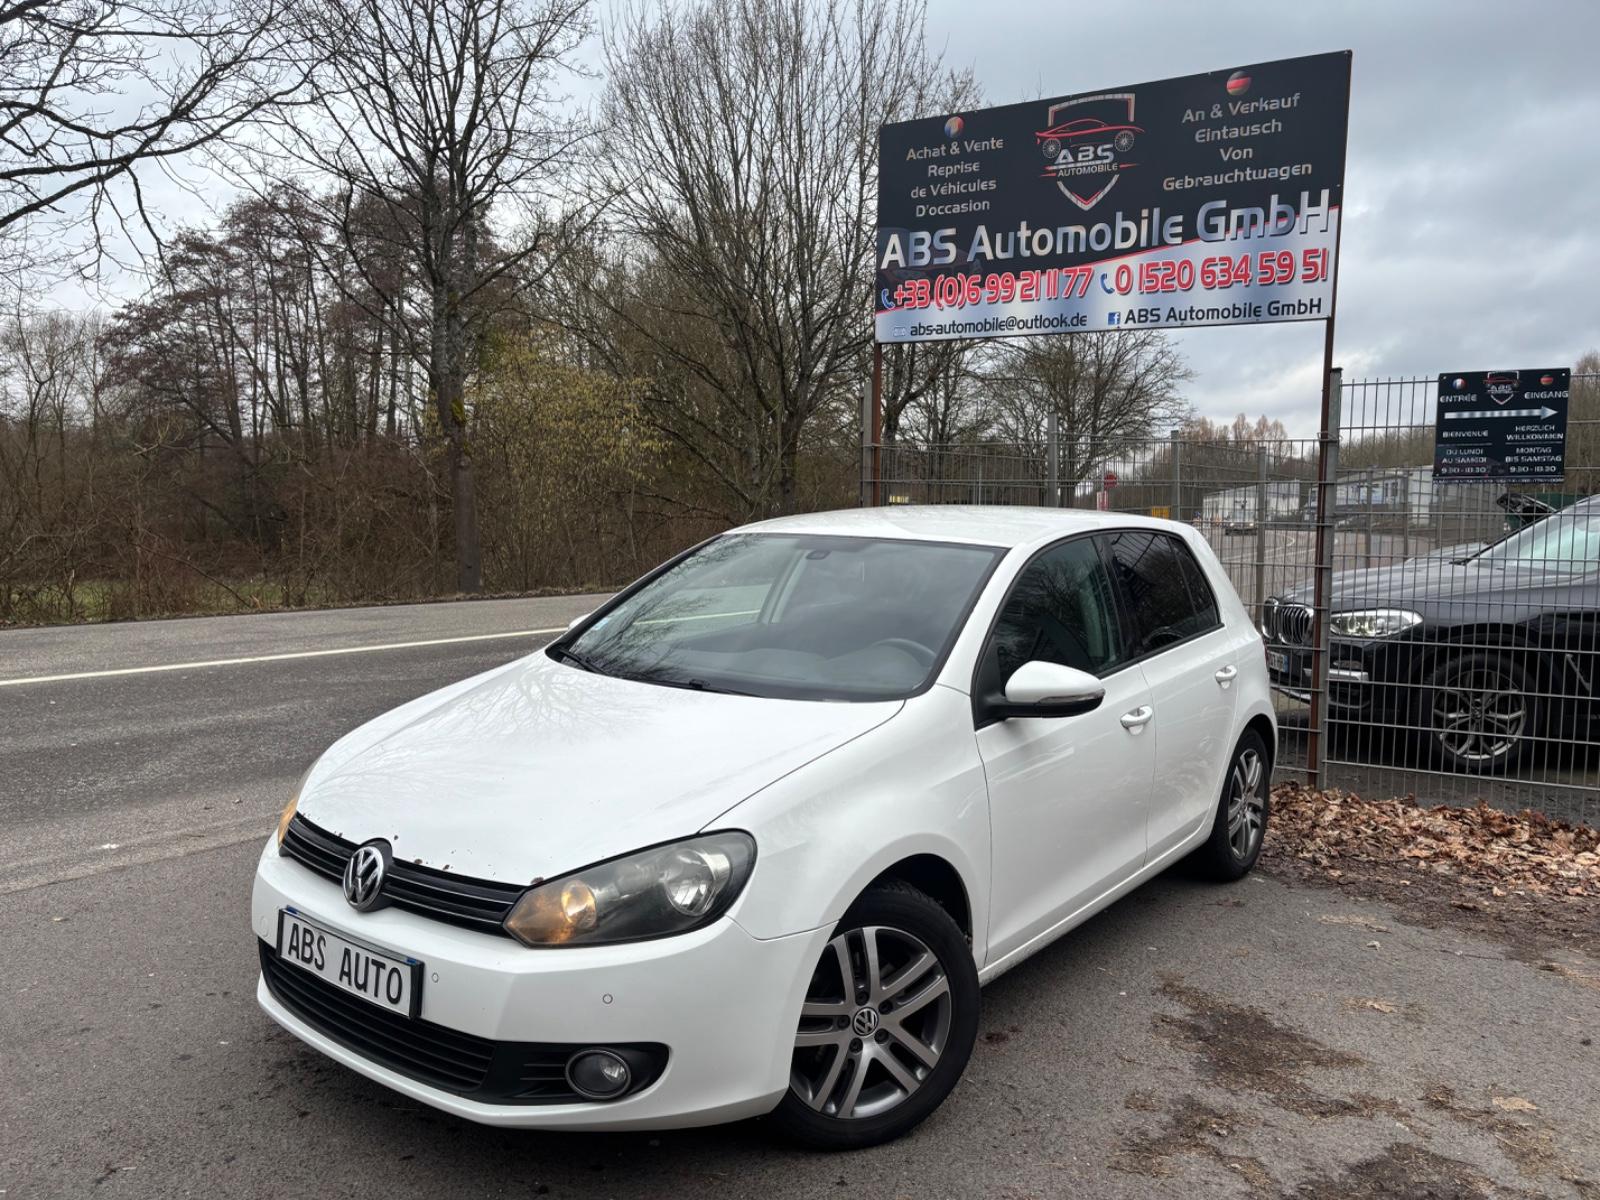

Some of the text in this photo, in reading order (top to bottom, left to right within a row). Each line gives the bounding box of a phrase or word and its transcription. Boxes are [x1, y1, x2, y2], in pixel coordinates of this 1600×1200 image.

[1182, 92, 1301, 123] An & Verkauf
[1195, 119, 1282, 143] Eintausch
[906, 137, 1004, 161] Achat & Vente
[1054, 143, 1114, 165] ABS
[1220, 147, 1253, 162] Von
[927, 161, 980, 178] Reprise
[1057, 163, 1118, 177] AUTOMOBILE
[1163, 163, 1312, 191] Gebrauchtwagen
[910, 179, 997, 199] de Véhicules
[915, 200, 990, 217] D'occasion
[880, 188, 1330, 270] ABS Automobile GmbH
[1114, 247, 1328, 296] 0 1520 634 59 51
[894, 267, 1095, 310] +33 (0)6 99 21 11 77
[1124, 298, 1322, 325] ABS Automobile GmbH
[910, 313, 1087, 336] abs-automobile@outlook.de
[1440, 393, 1477, 403] ENTRÉE
[1524, 390, 1569, 400] EINGANG
[1442, 430, 1488, 438] BIENVENUE
[1515, 424, 1555, 432] HERZLICH
[1515, 446, 1552, 454] MONTAG
[288, 922, 403, 1004] ABS AUTO
